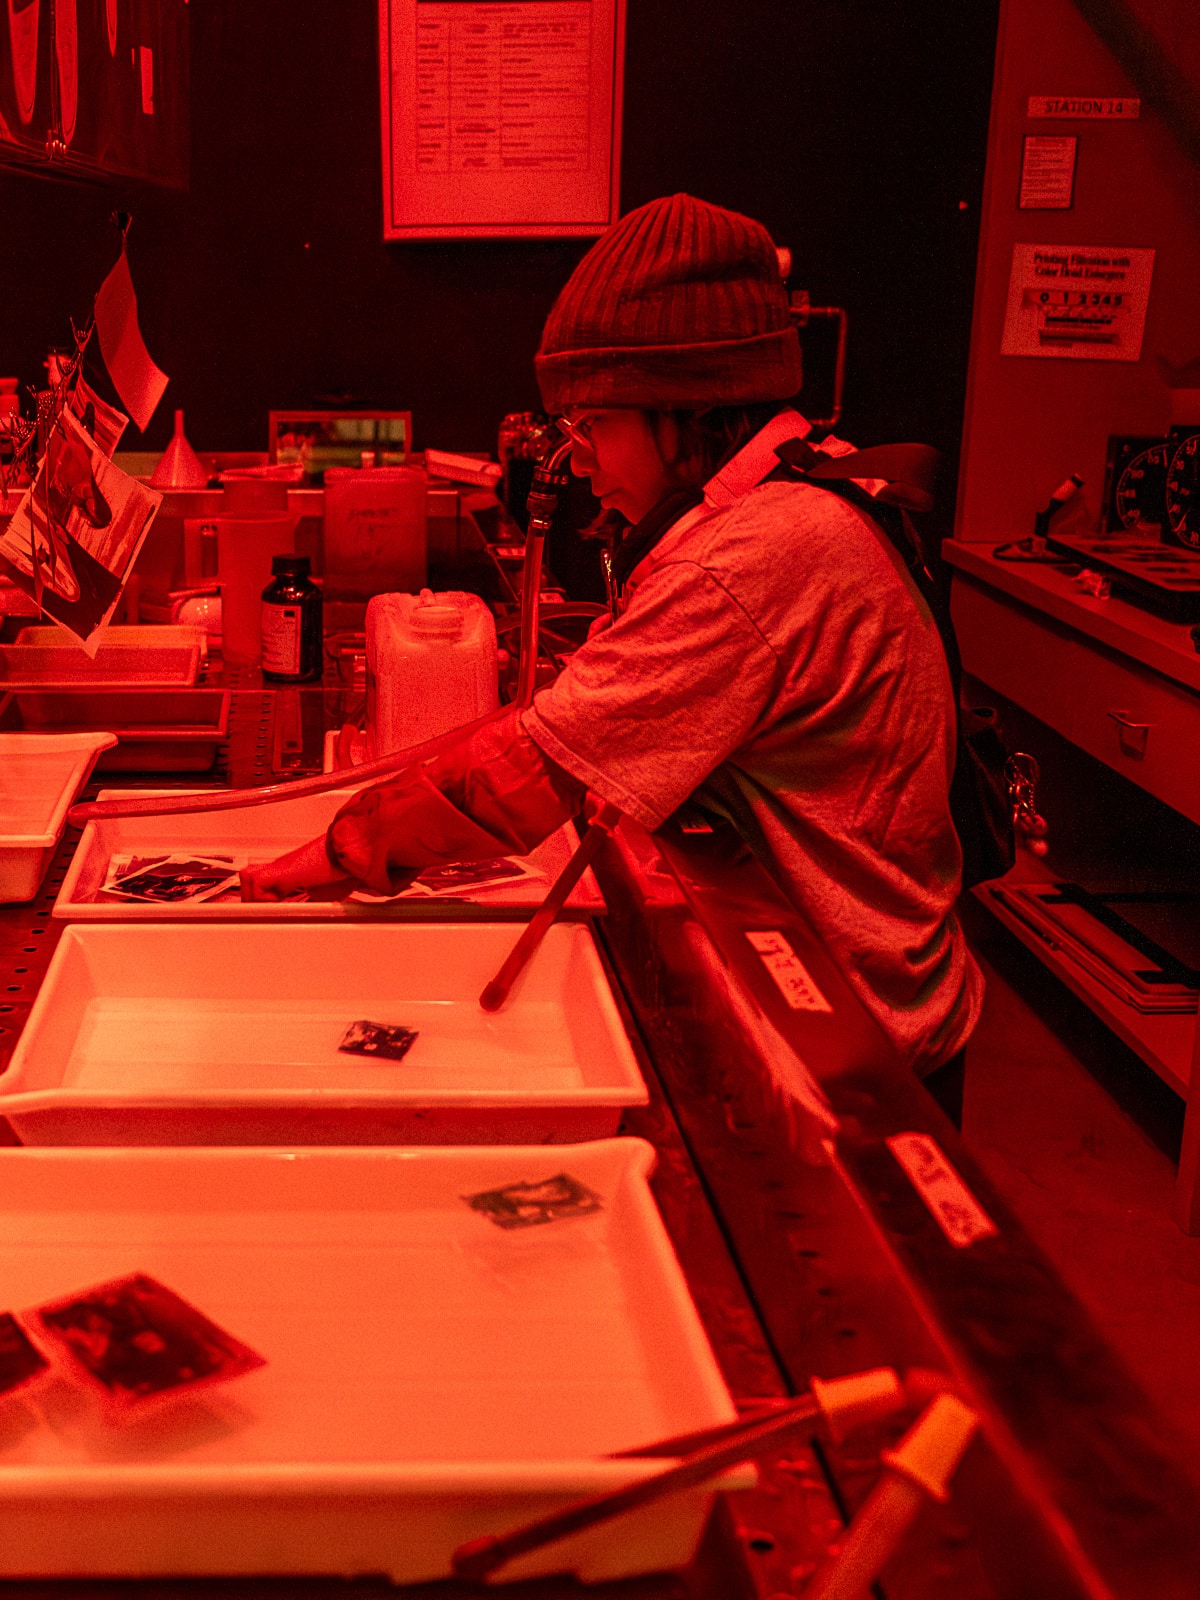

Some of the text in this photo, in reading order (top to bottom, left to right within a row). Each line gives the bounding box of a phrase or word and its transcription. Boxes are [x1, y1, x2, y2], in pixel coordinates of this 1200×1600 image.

[1045, 100, 1122, 114] STATION 14
[1112, 256, 1130, 267] with
[1035, 267, 1058, 276] Color
[1040, 292, 1122, 306] 0 1 2 3 4 5
